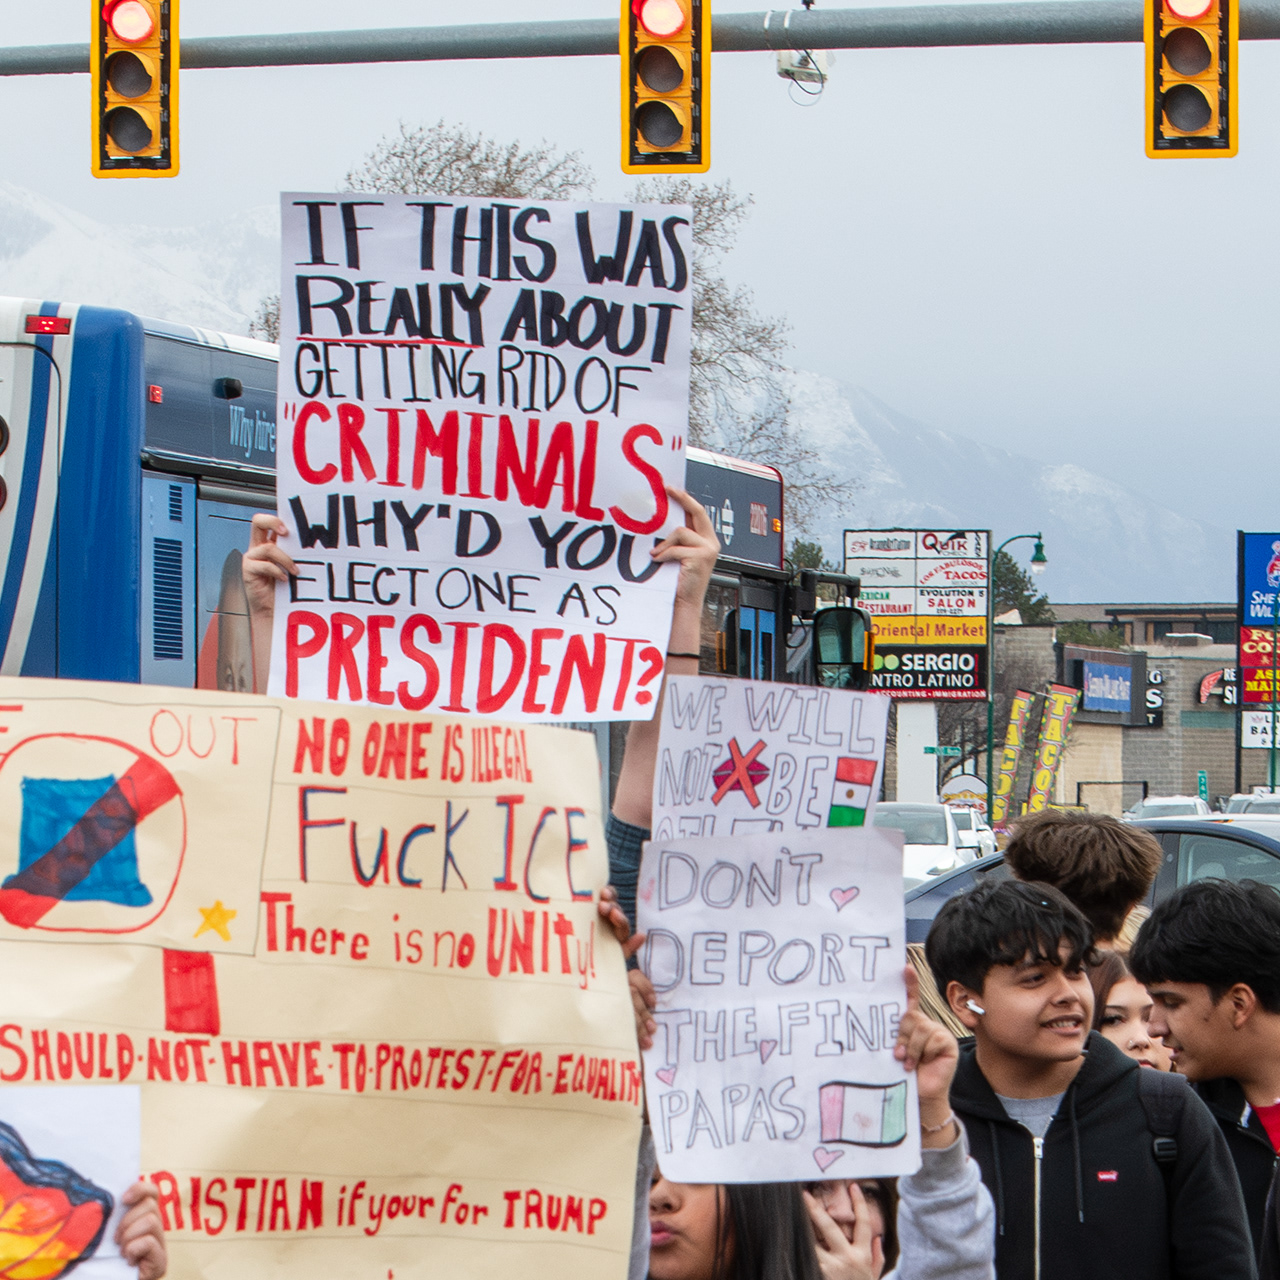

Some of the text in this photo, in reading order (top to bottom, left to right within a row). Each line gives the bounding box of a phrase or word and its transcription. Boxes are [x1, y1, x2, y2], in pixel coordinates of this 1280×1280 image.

[293, 201, 690, 292] IF THIS WAS
[296, 276, 681, 363] REALLY ABOUT
[295, 343, 652, 416] GETTING RID OF
[230, 405, 254, 458] Why
[285, 401, 683, 535] "CRIMINALS"
[289, 494, 665, 583] WHY'D YOU
[289, 561, 621, 625] ELECT ONE AS
[859, 592, 890, 600] EXICAN
[928, 598, 976, 608] SALON
[944, 571, 987, 580] TACOS
[285, 611, 664, 714] PRESIDENT?
[872, 623, 984, 636] Oriental Market
[902, 654, 975, 671] SERGIO
[869, 674, 974, 687] NTRO LATINO
[149, 710, 258, 764] OUT
[294, 718, 532, 784] NO ONE IS ILLEGAL
[669, 683, 876, 754] WE WILL
[659, 743, 829, 826] NOT BE
[494, 794, 596, 902] ICE
[658, 847, 822, 911] DON'T
[260, 892, 370, 960] There
[394, 913, 424, 965] is
[434, 930, 474, 969] no
[645, 928, 890, 993] DEPORT
[147, 1037, 209, 1084] NOT
[223, 1041, 324, 1087] HAVE
[653, 1000, 903, 1066] THE FINE
[659, 1076, 805, 1153] PAPAS
[137, 1170, 608, 1236] RISTIAN if your for TRUMP
